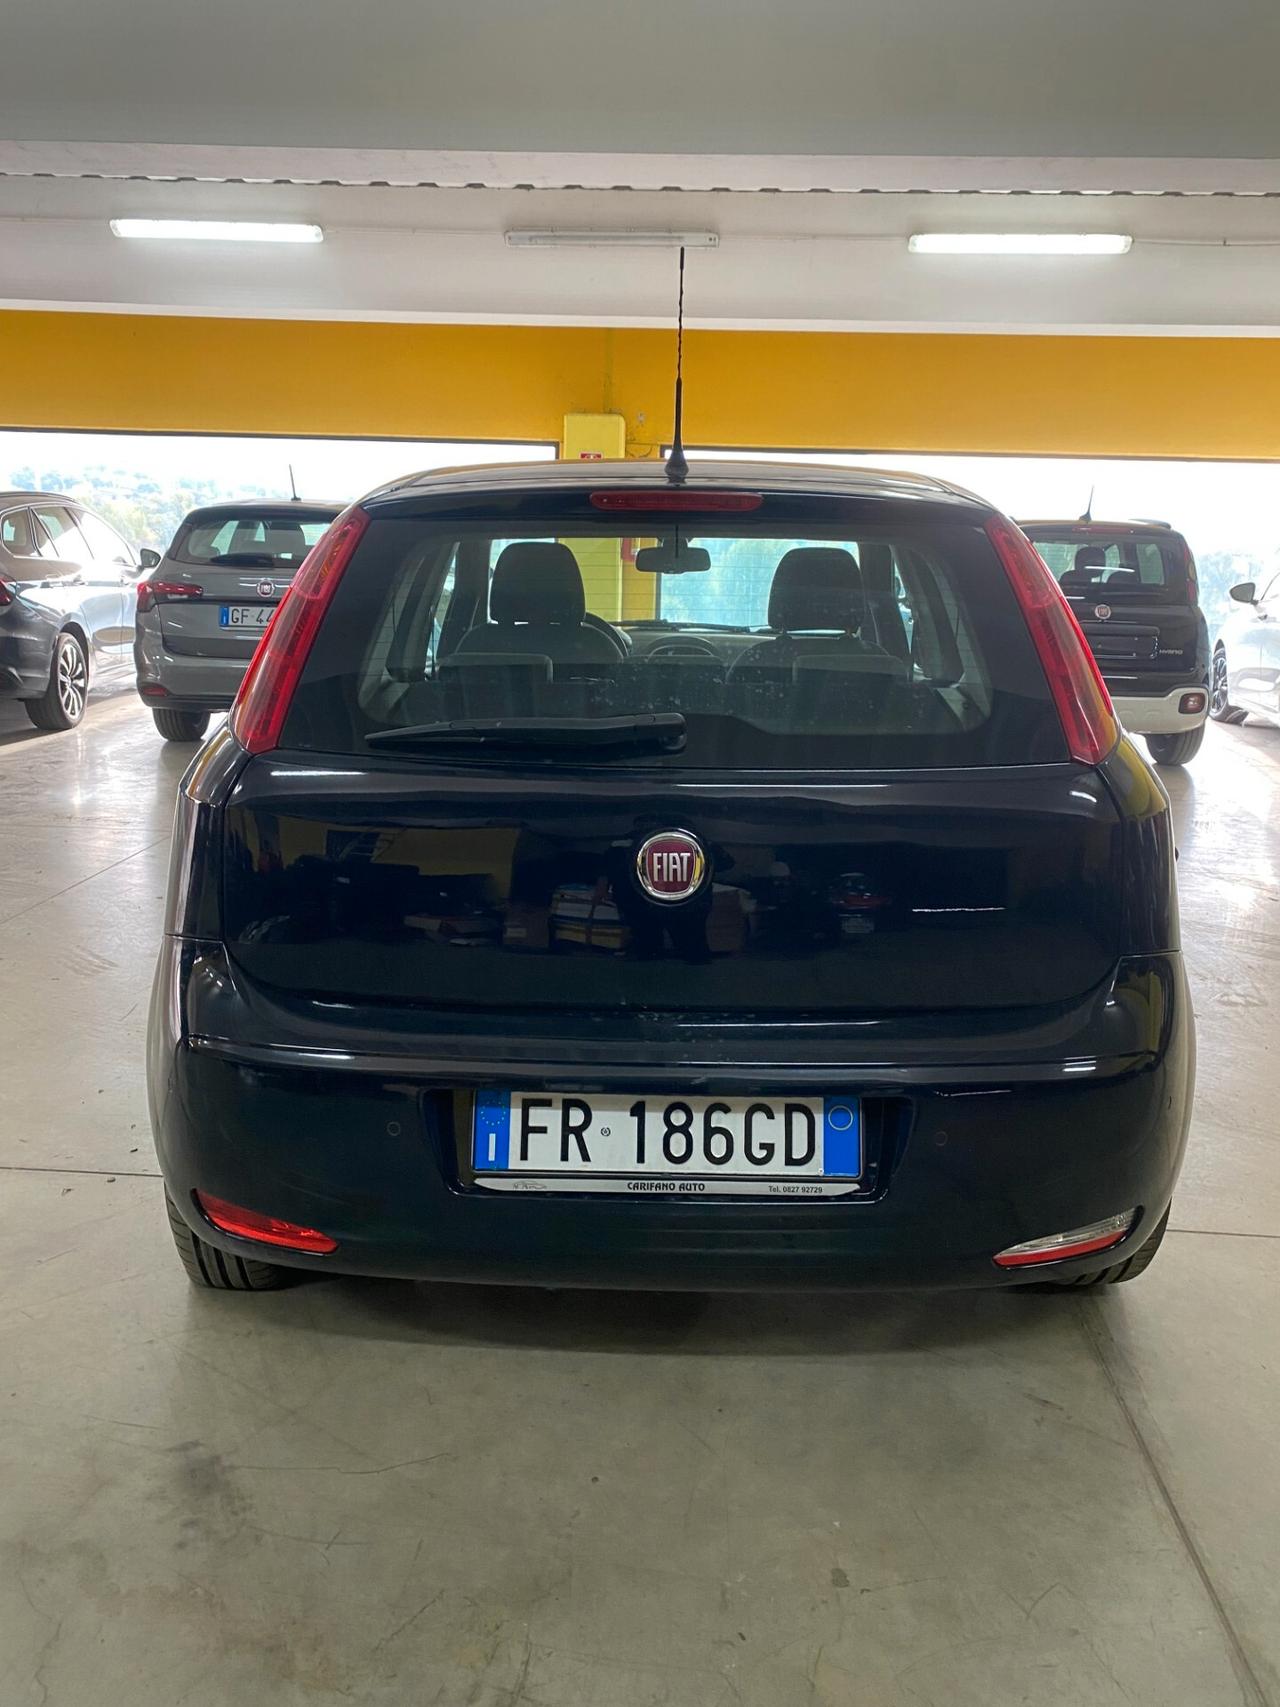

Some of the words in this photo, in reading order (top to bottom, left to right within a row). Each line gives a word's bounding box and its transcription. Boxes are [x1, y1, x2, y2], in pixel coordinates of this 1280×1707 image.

[231, 608, 250, 624] GF
[653, 852, 691, 882] FIAT
[520, 1098, 593, 1163] FR
[629, 1100, 817, 1167] 186GD
[627, 1182, 676, 1192] CARIFANO
[678, 1182, 705, 1192] AUTO
[768, 1185, 781, 1194] Tel.
[782, 1185, 801, 1194] 0827
[801, 1186, 823, 1194] 92729
